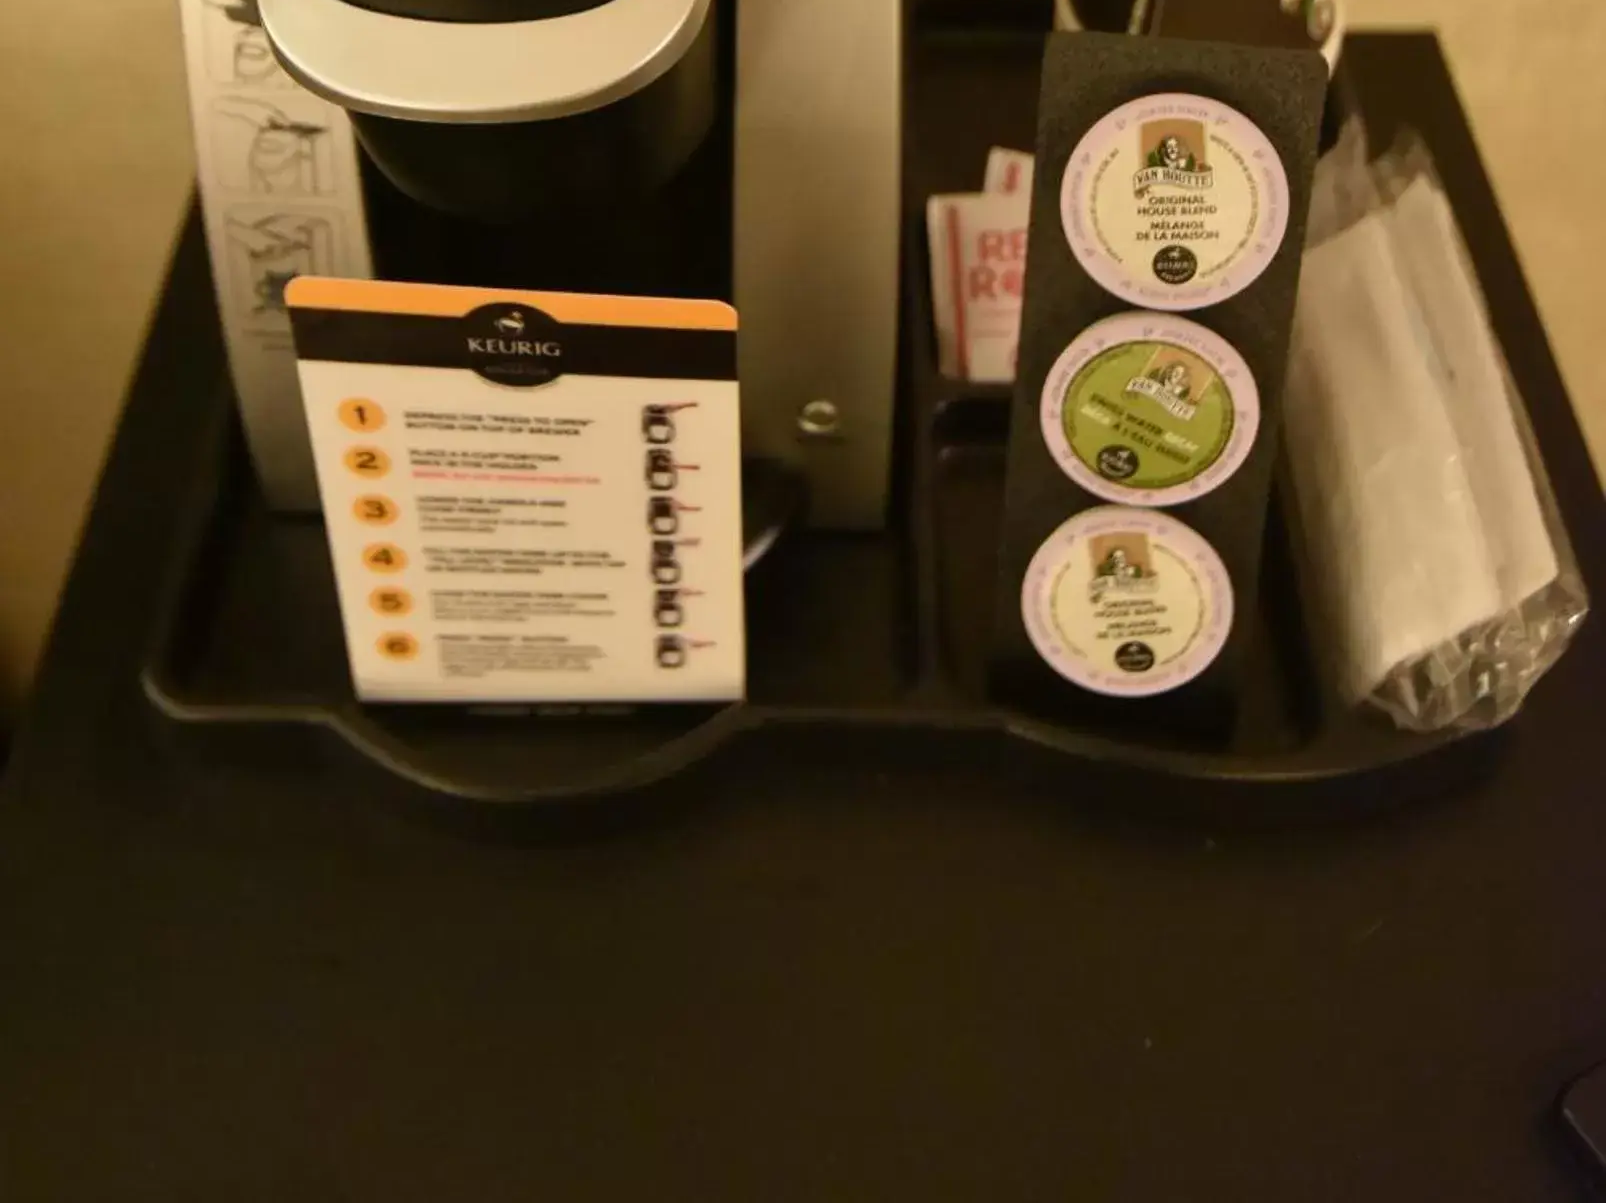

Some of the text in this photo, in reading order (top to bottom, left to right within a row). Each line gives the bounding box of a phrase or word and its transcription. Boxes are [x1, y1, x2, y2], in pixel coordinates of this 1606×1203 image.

[1148, 195, 1205, 205] ORIGINAL
[1137, 205, 1218, 216] HOUSE BLEND
[1153, 231, 1168, 241] LA
[1171, 230, 1220, 241] MAISON
[467, 337, 562, 357] KEURIG
[354, 405, 366, 426] 1
[356, 451, 380, 471] 2
[364, 499, 388, 520] 3
[371, 548, 394, 566] 4
